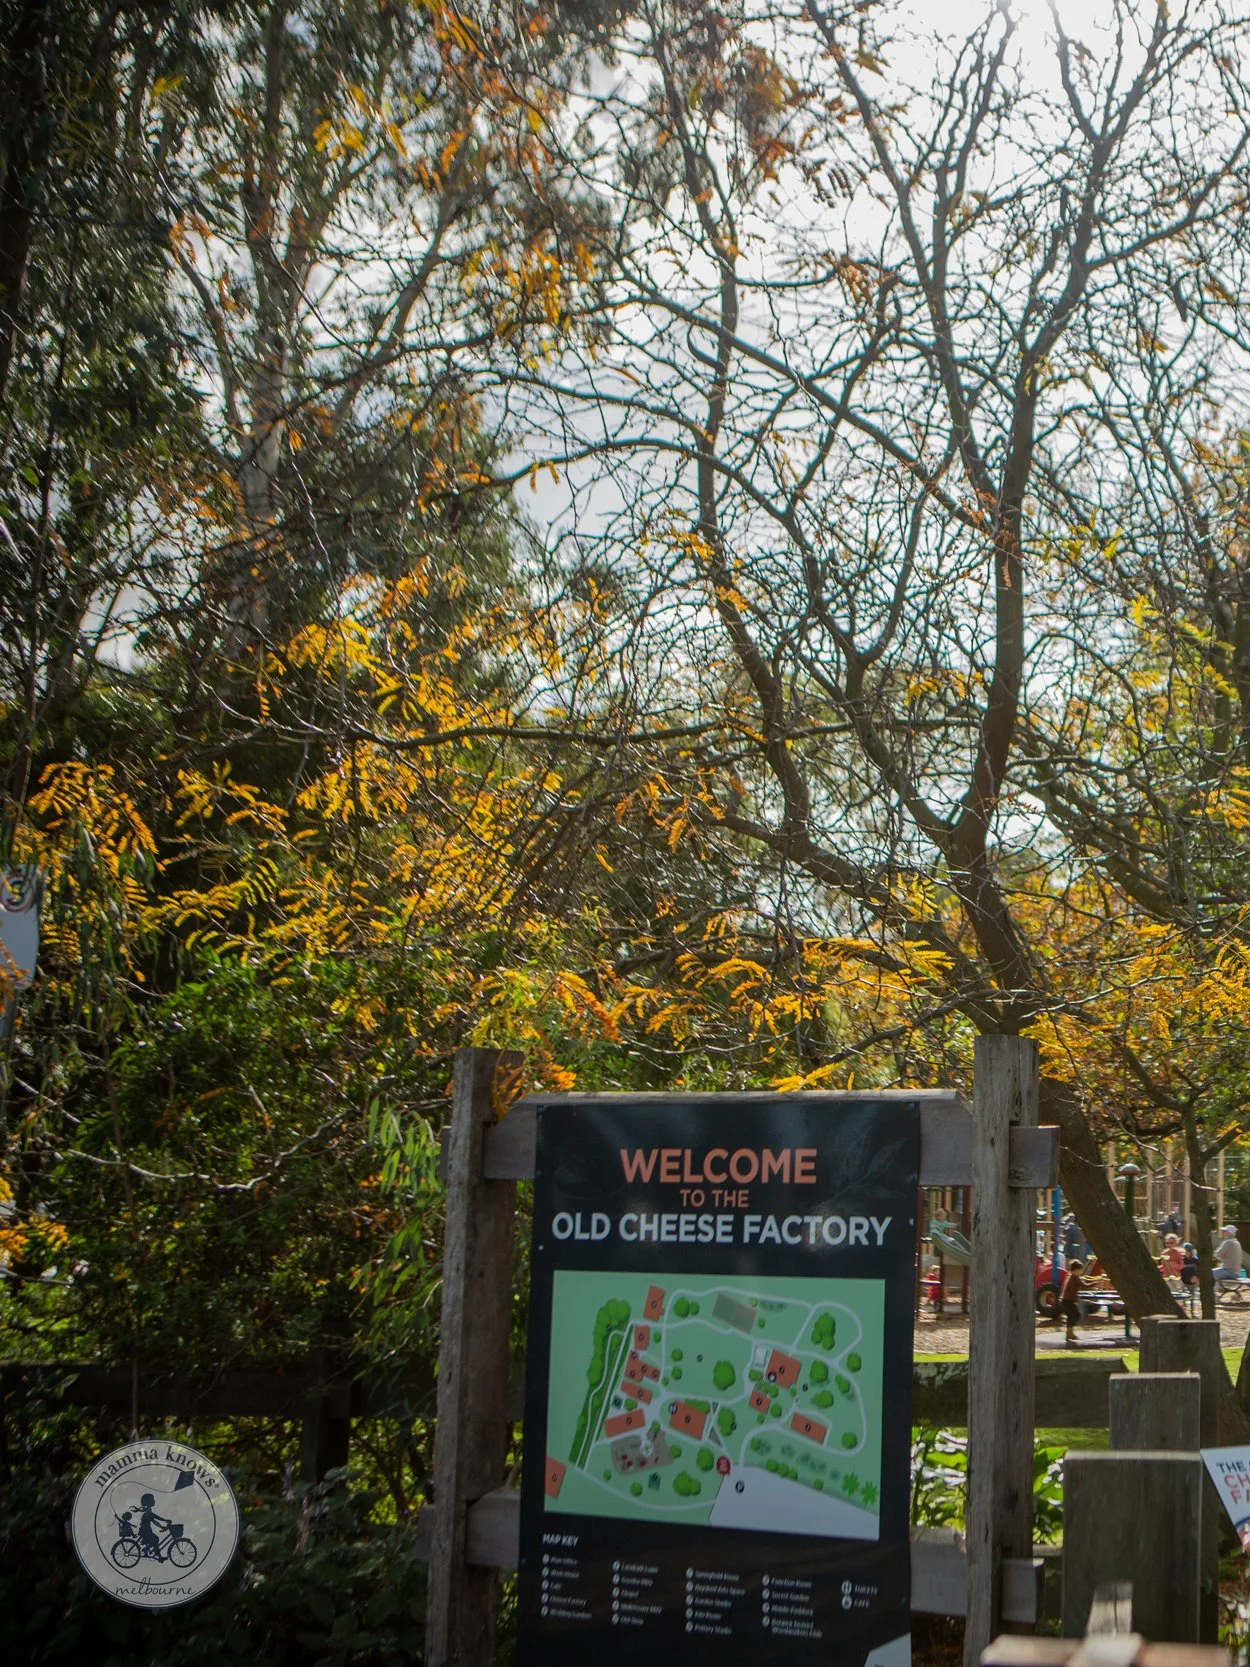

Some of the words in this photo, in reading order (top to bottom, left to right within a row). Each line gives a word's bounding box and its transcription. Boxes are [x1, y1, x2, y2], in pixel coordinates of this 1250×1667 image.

[620, 1148, 817, 1185] WELCOME
[680, 1189, 705, 1208] TO
[712, 1189, 749, 1209] THE
[552, 1212, 611, 1241] OLD
[618, 1213, 734, 1243] CHEESE
[743, 1215, 892, 1247] FACTORY
[1216, 1460, 1247, 1474] THE
[542, 1533, 561, 1545] MAP
[561, 1535, 579, 1548] KEY
